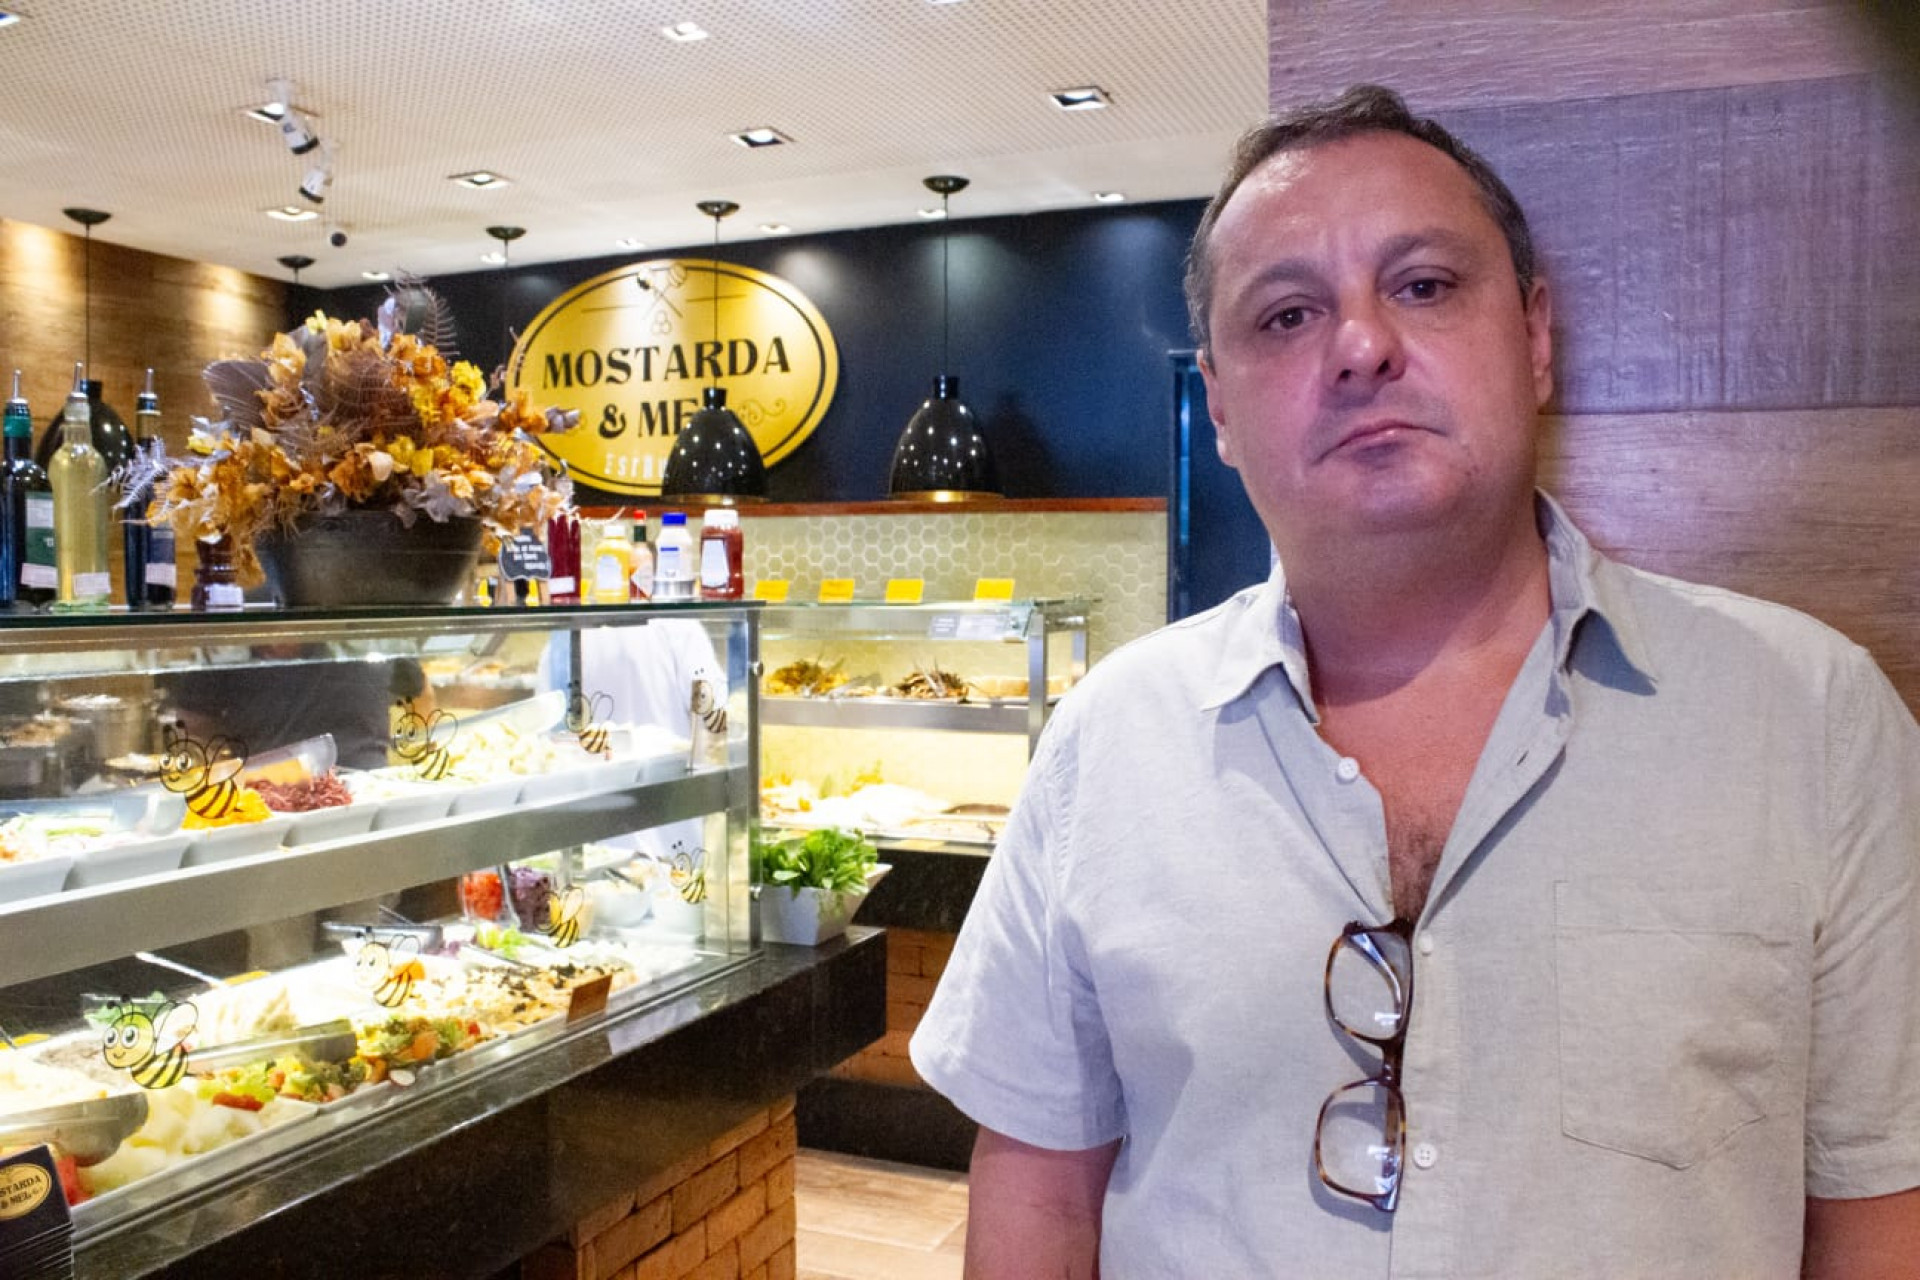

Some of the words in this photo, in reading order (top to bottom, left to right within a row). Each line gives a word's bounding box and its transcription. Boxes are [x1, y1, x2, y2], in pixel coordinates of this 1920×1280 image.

[543, 337, 791, 389] MOSTARDA
[598, 403, 627, 439] &
[638, 398, 699, 438] ME
